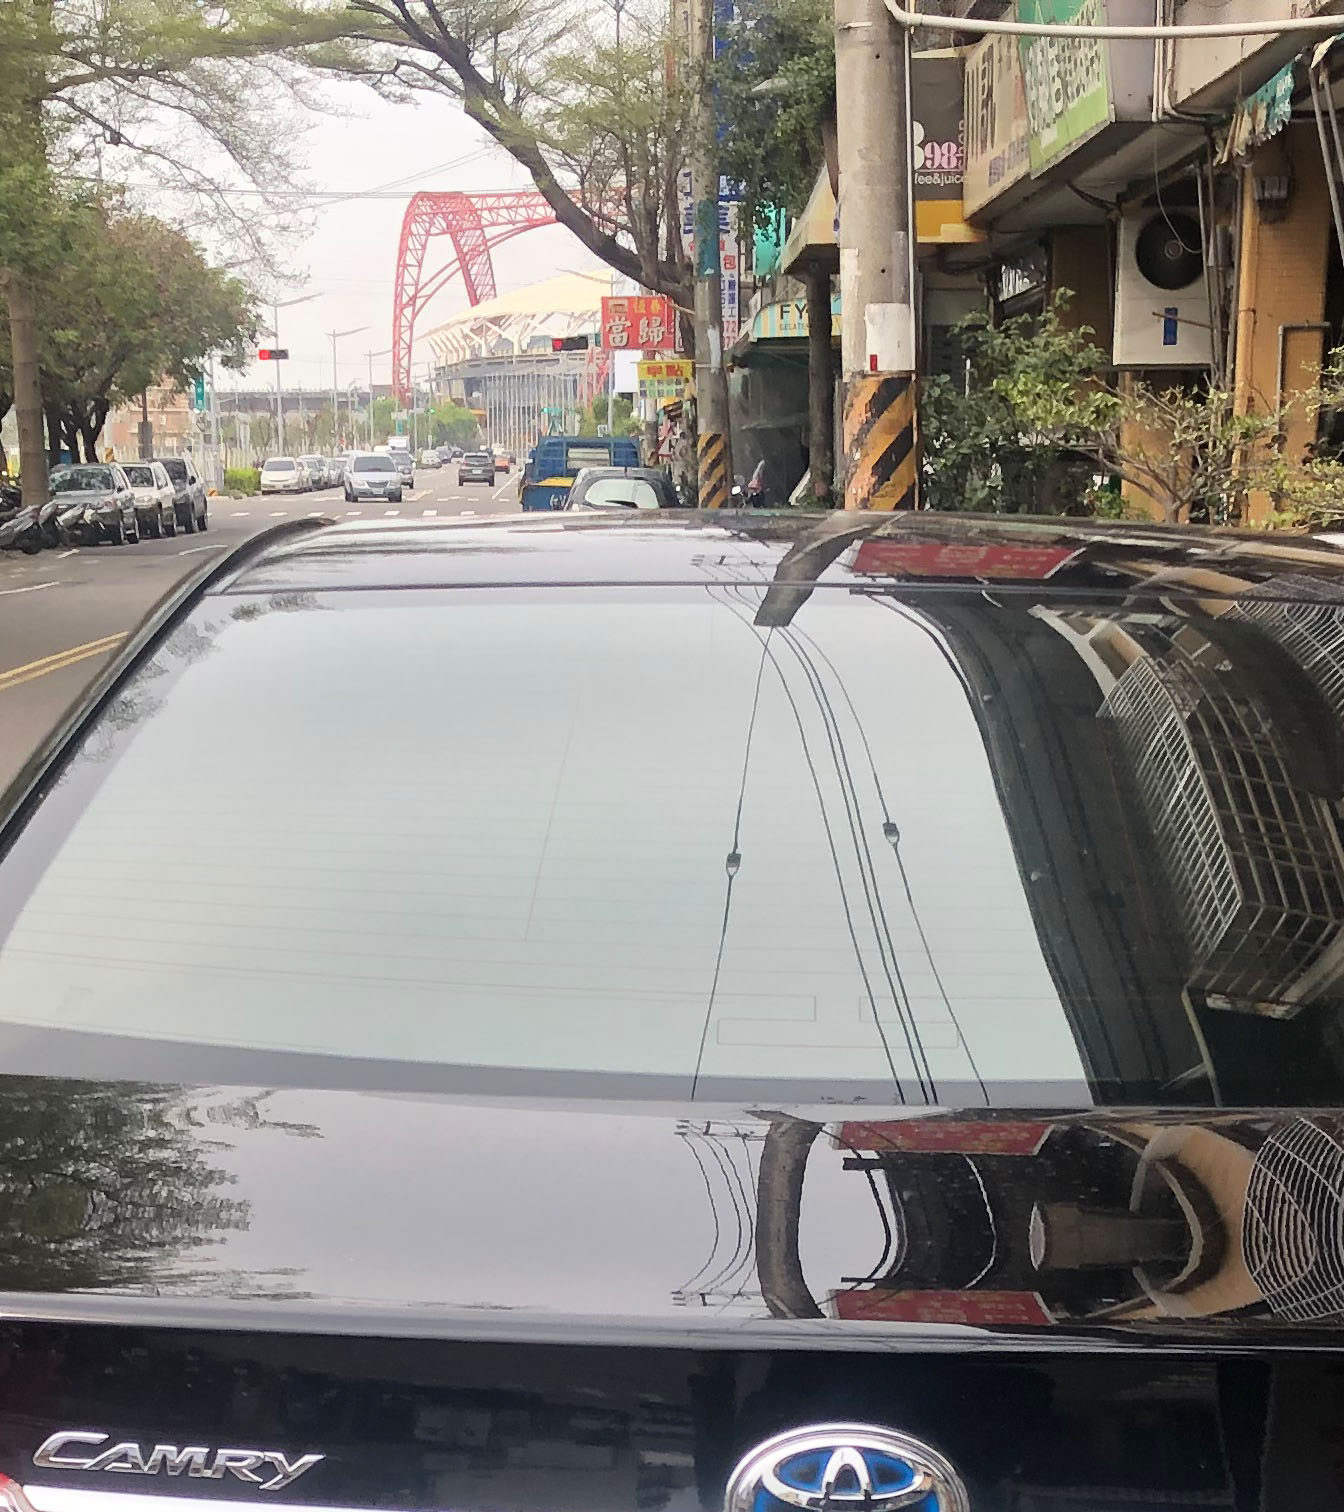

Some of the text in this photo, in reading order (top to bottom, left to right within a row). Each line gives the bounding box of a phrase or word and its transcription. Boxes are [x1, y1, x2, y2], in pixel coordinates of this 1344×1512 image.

[780, 303, 808, 320] FY
[606, 315, 666, 348] 當歸
[33, 1430, 327, 1491] CAMRY
